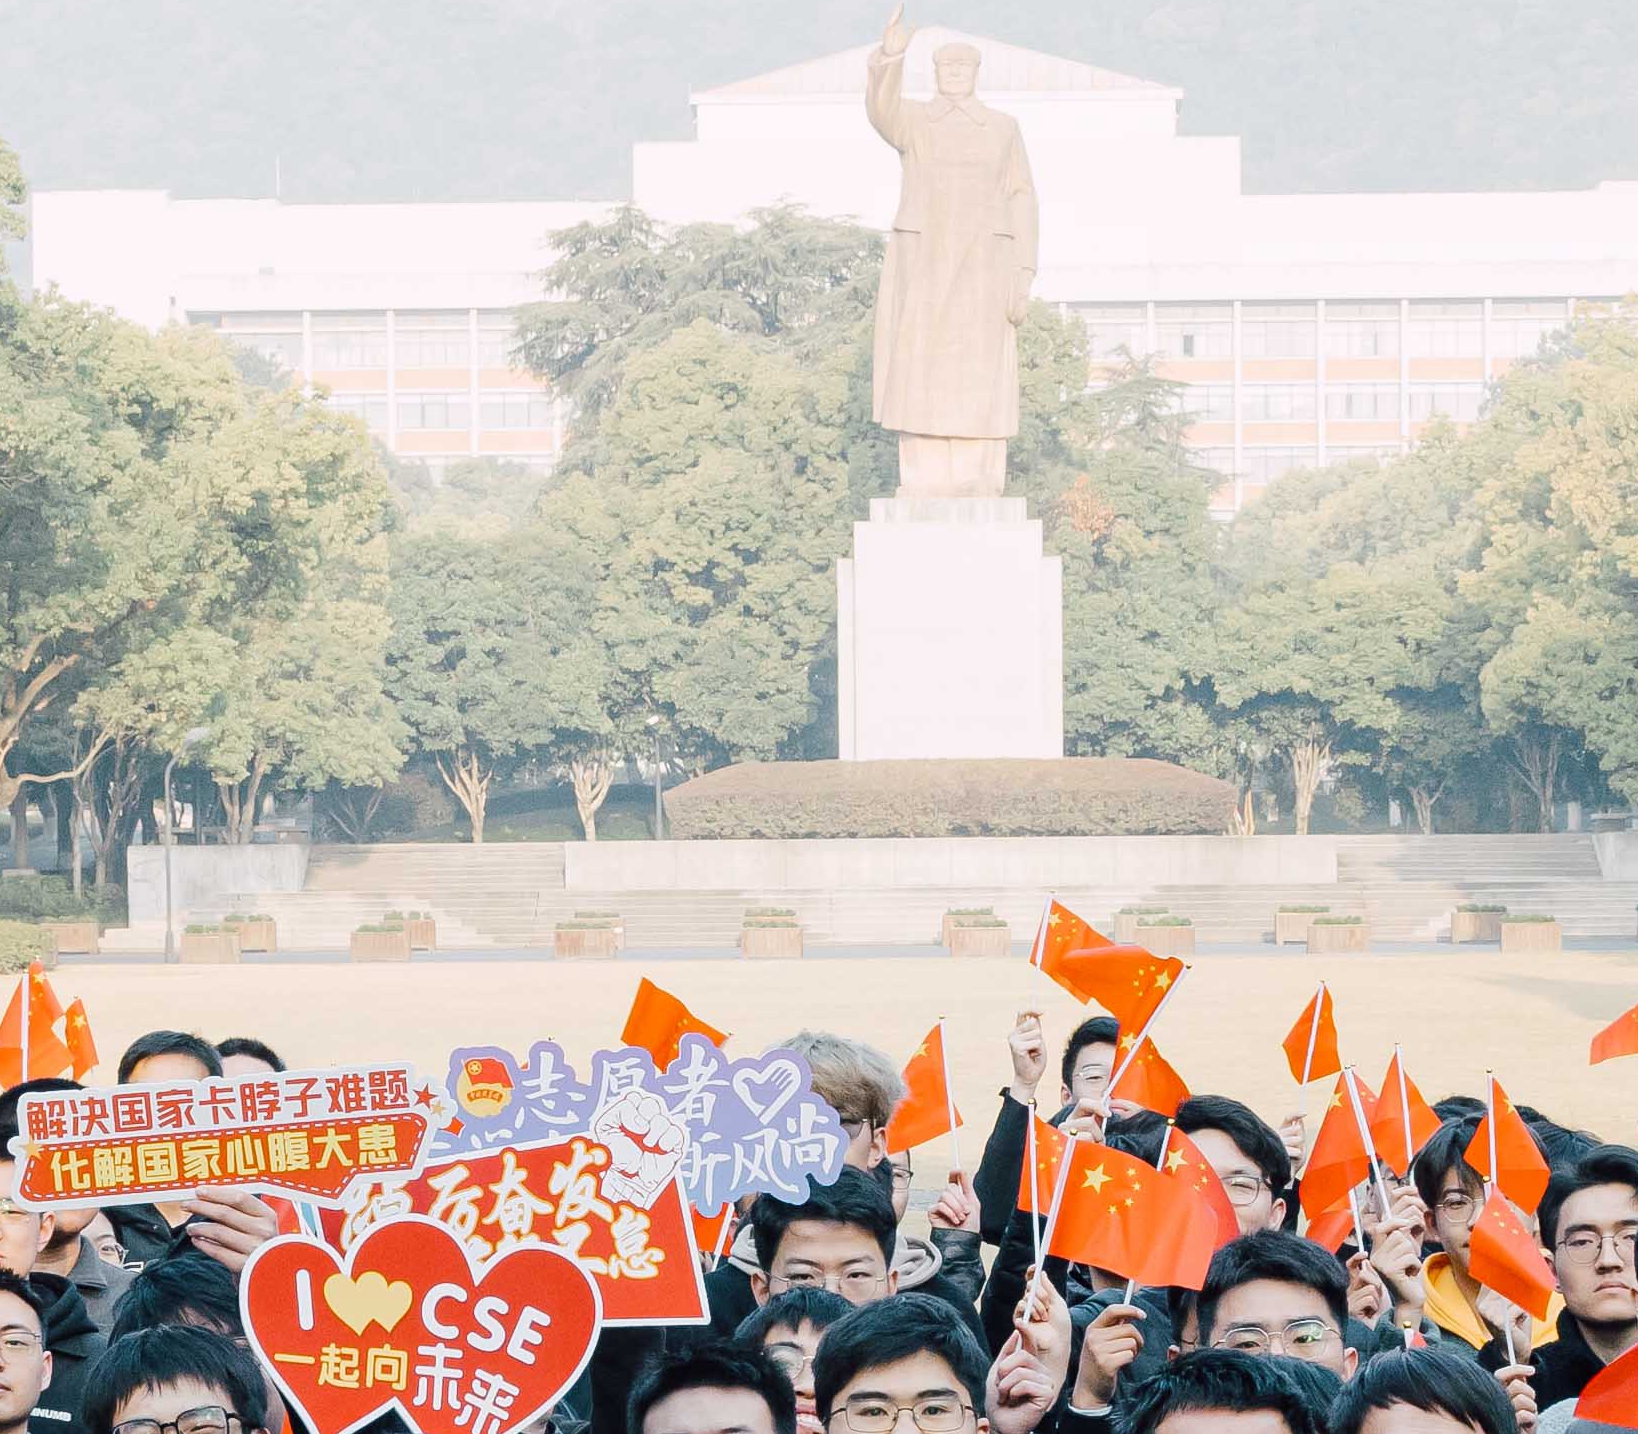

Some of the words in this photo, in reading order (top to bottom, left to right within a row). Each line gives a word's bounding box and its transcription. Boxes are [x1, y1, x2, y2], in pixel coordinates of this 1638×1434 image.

[27, 1069, 409, 1140] 解决国家卡脖子难题
[49, 1122, 399, 1192] 化解国家心腹大患
[295, 1268, 316, 1332] I
[421, 1282, 552, 1366] CSE
